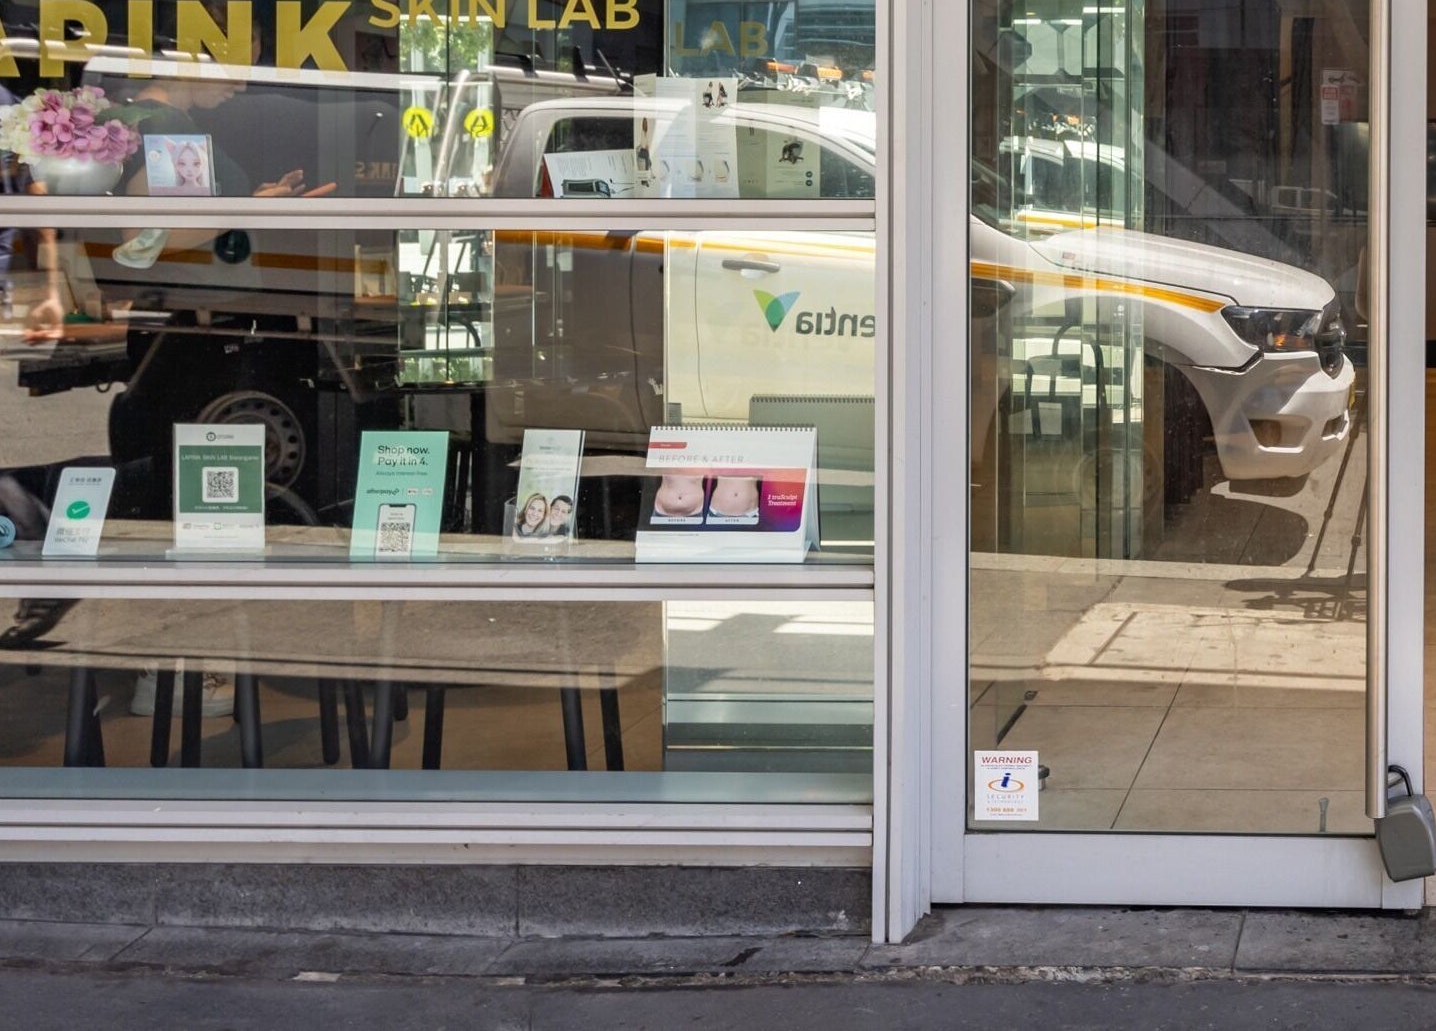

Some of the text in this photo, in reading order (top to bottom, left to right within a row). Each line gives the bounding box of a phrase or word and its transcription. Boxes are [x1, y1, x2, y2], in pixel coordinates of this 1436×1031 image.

[378, 445, 430, 456] Shop now.
[378, 457, 429, 467] Pay it in 4.
[658, 455, 699, 463] BEFORE
[712, 455, 744, 464] AFTER
[981, 756, 1033, 764] WARNING
